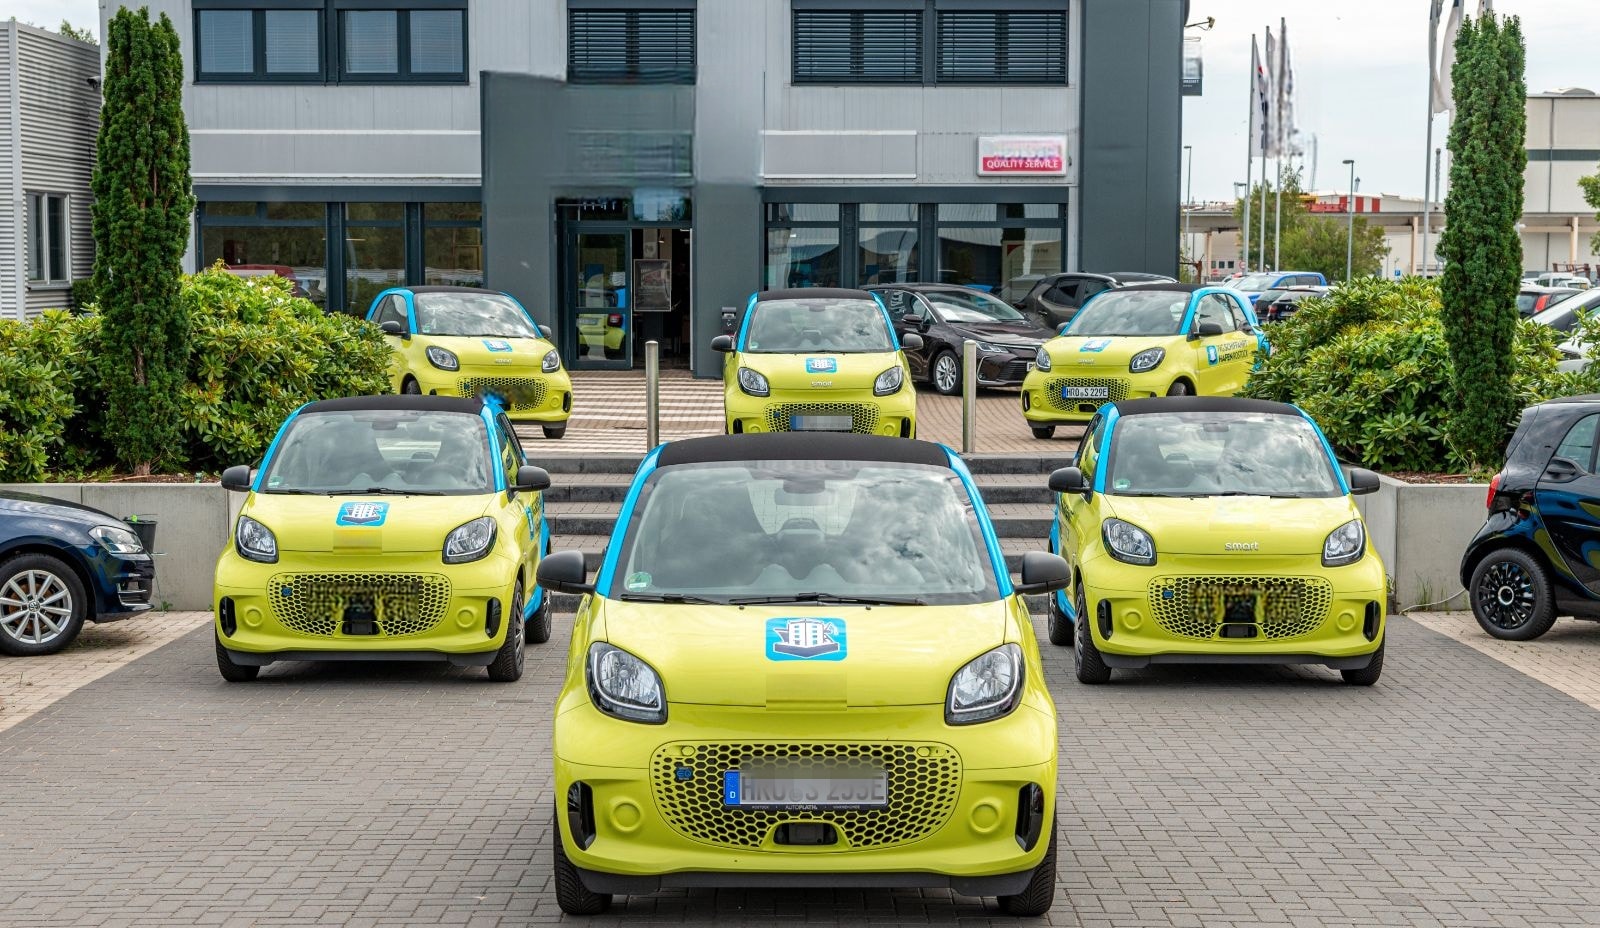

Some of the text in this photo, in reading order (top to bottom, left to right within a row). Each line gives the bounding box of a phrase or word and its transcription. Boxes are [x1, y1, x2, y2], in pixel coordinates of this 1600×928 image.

[987, 160, 1058, 168] QUALITY SERVICE
[1084, 388, 1088, 396] S
[1090, 388, 1107, 396] 229E
[1224, 541, 1259, 550] smart
